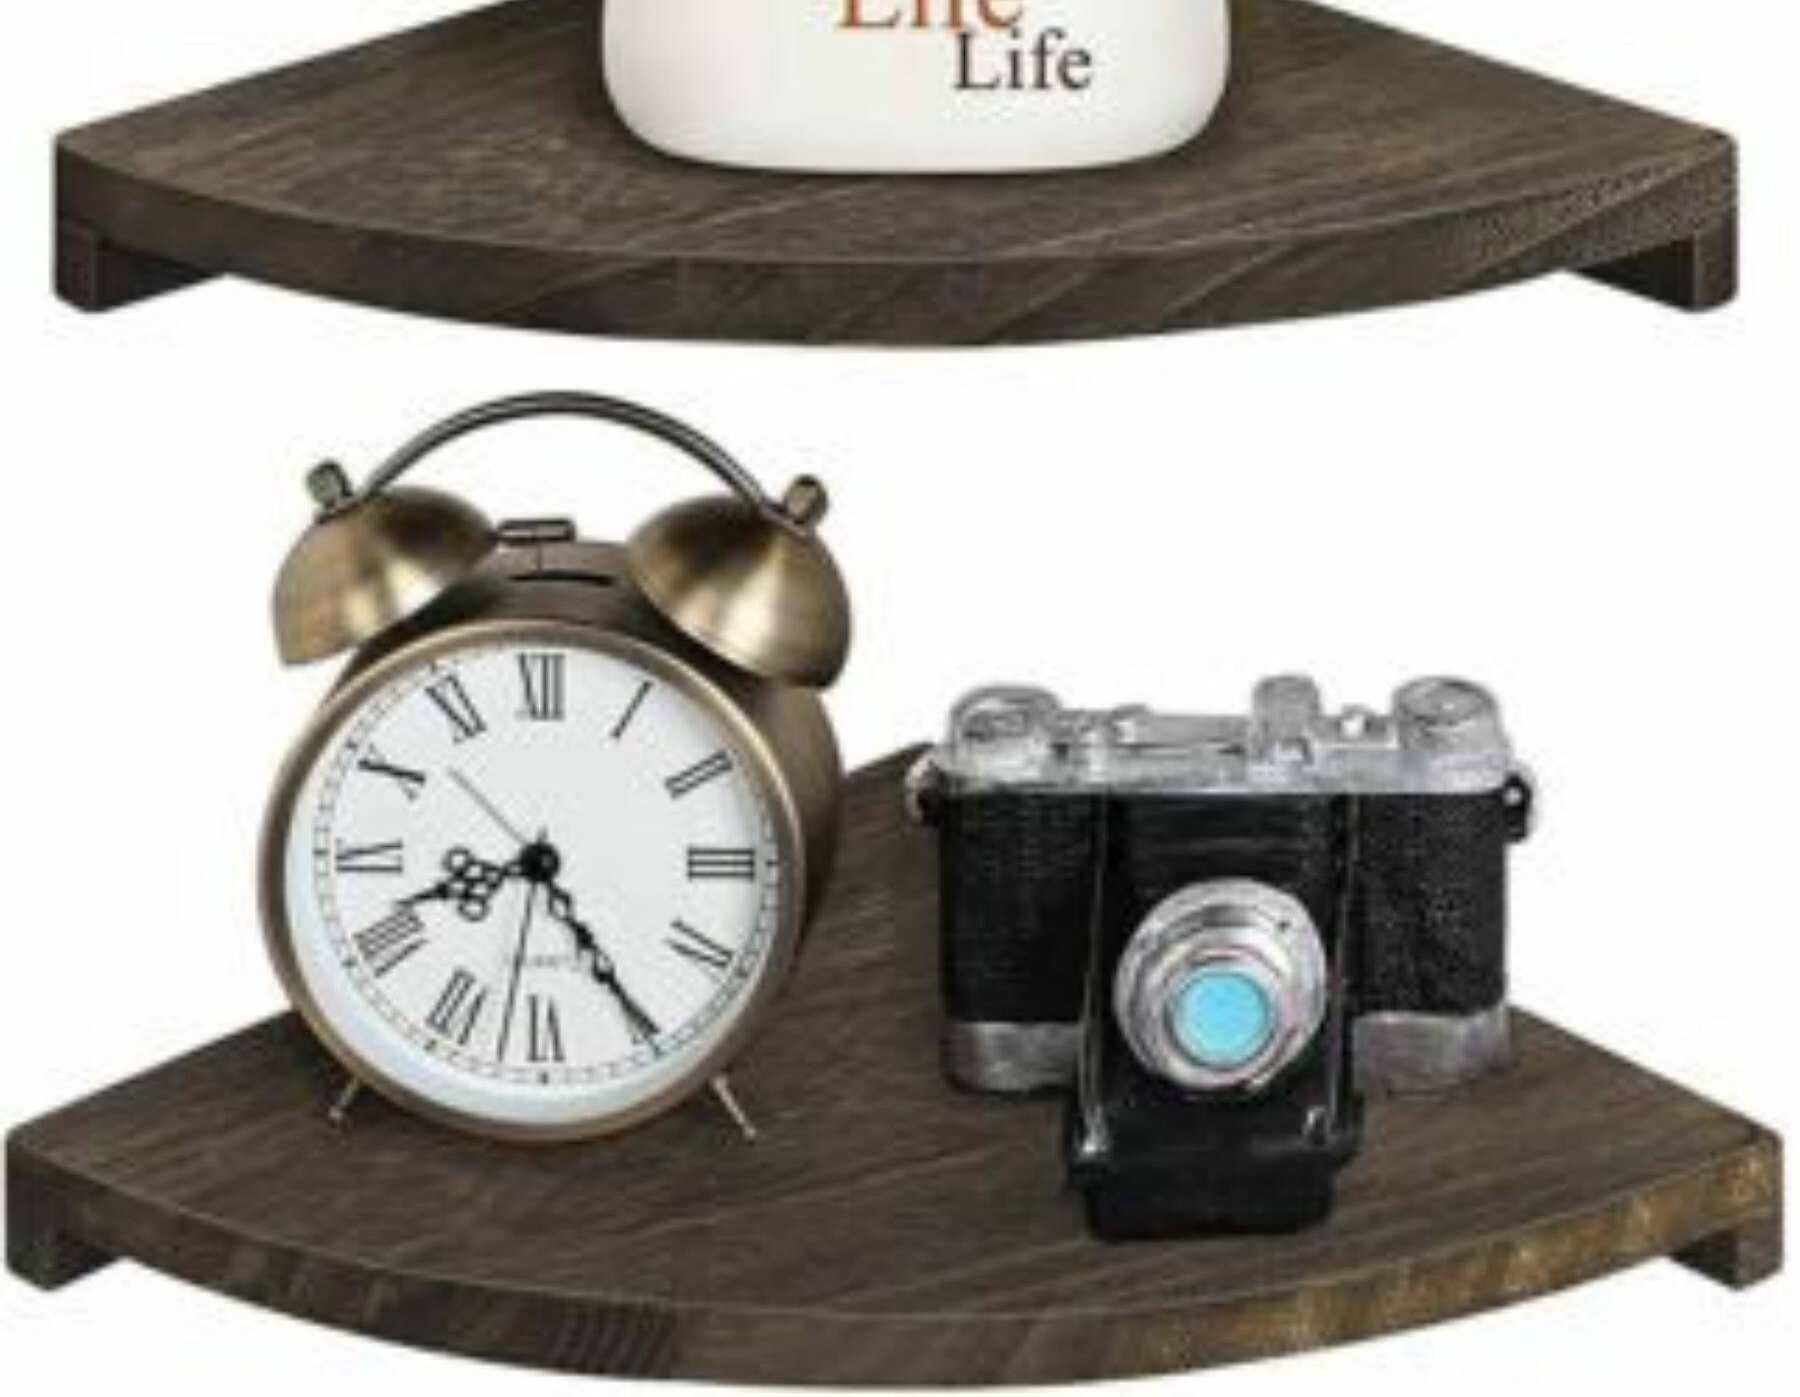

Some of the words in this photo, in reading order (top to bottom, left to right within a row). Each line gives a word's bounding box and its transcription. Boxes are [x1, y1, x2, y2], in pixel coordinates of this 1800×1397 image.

[953, 26, 1093, 91] Life
[423, 672, 489, 744] XI
[514, 652, 566, 722] XII
[610, 679, 655, 739] I
[664, 750, 734, 800] II
[686, 846, 756, 881] III
[424, 967, 488, 1045] VII
[526, 992, 567, 1064] VI
